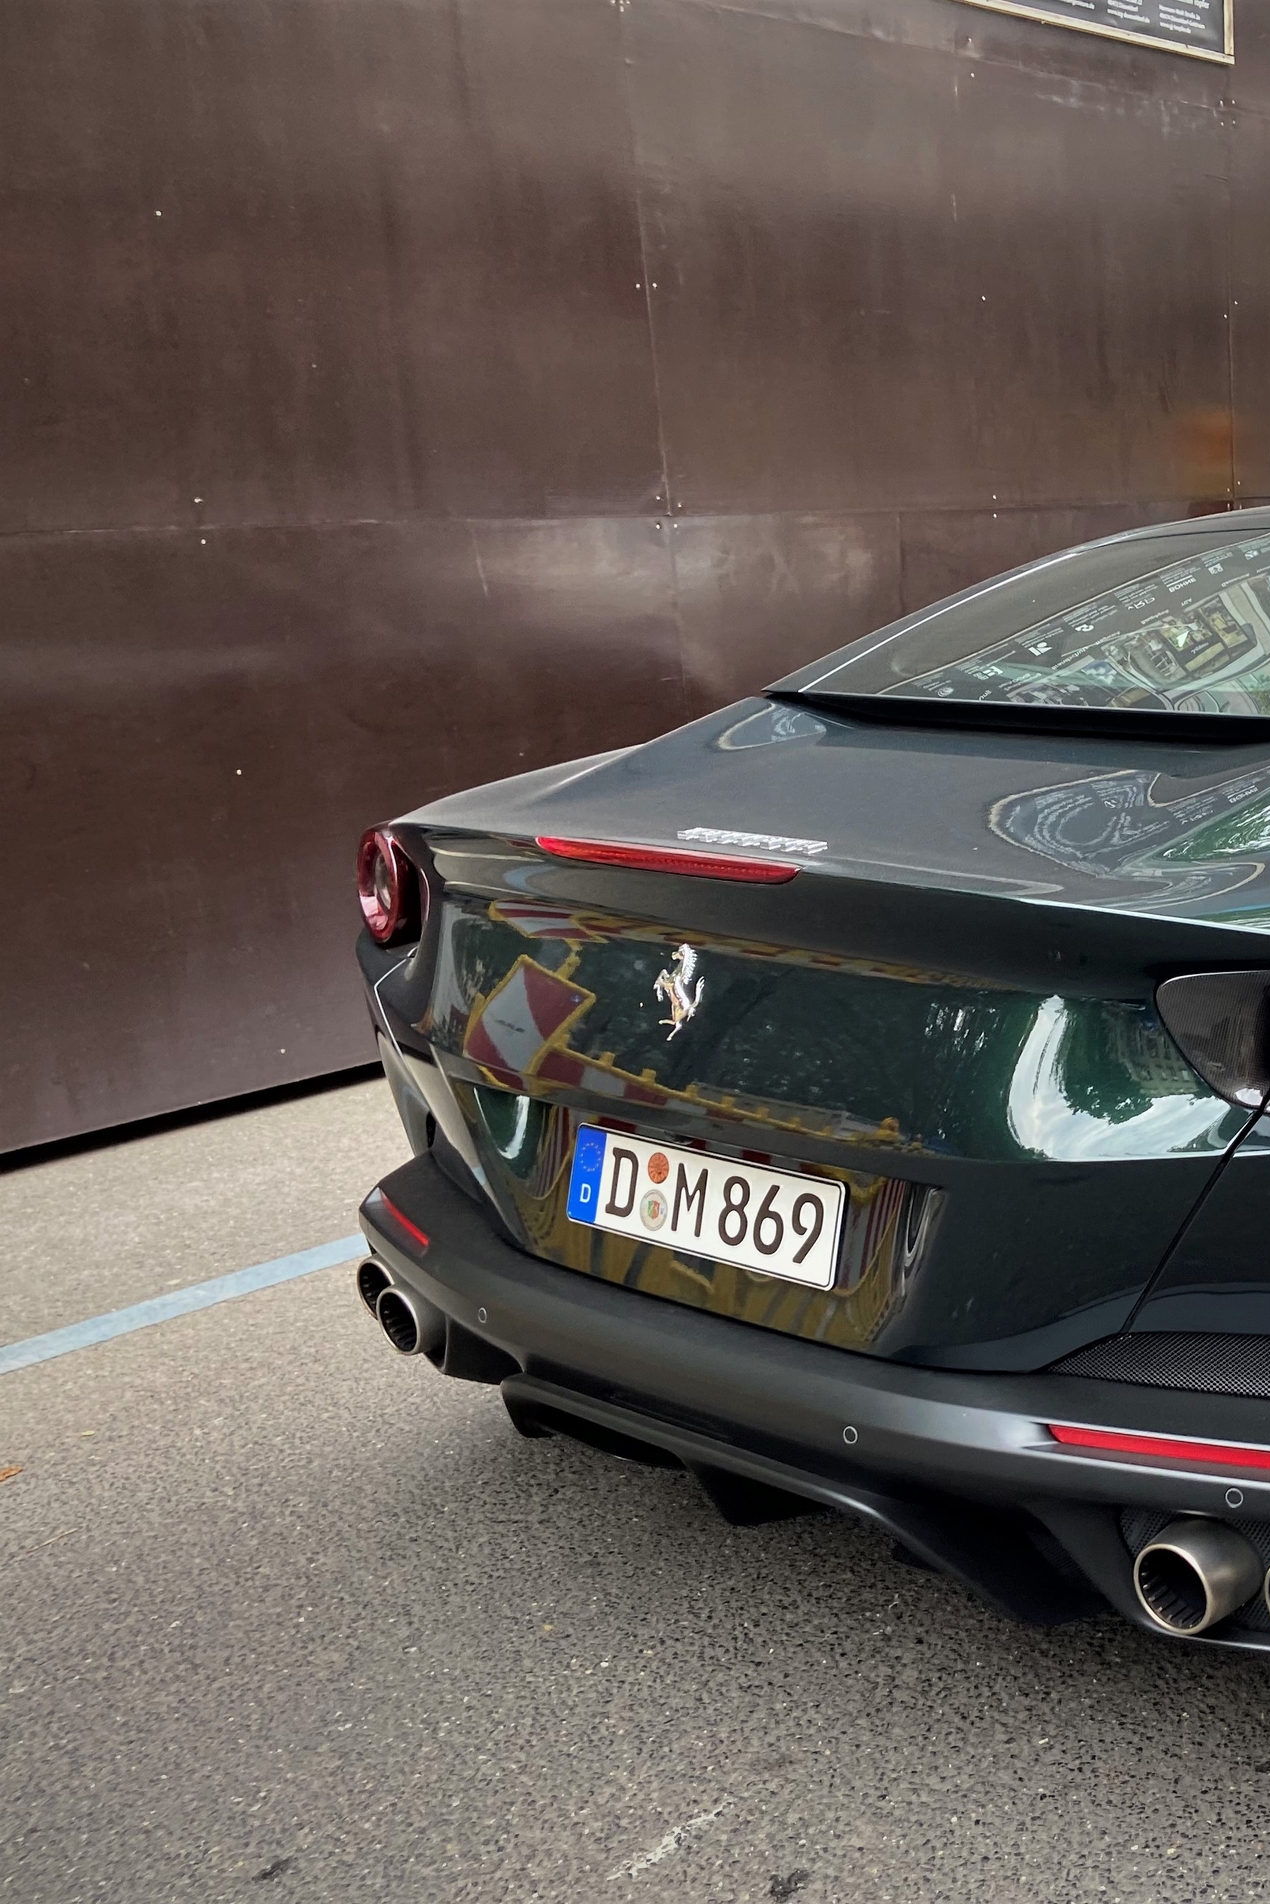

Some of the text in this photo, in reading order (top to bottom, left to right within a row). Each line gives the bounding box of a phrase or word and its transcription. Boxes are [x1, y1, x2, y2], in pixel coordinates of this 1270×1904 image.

[580, 1183, 592, 1204] D
[605, 1146, 825, 1265] D M 869
